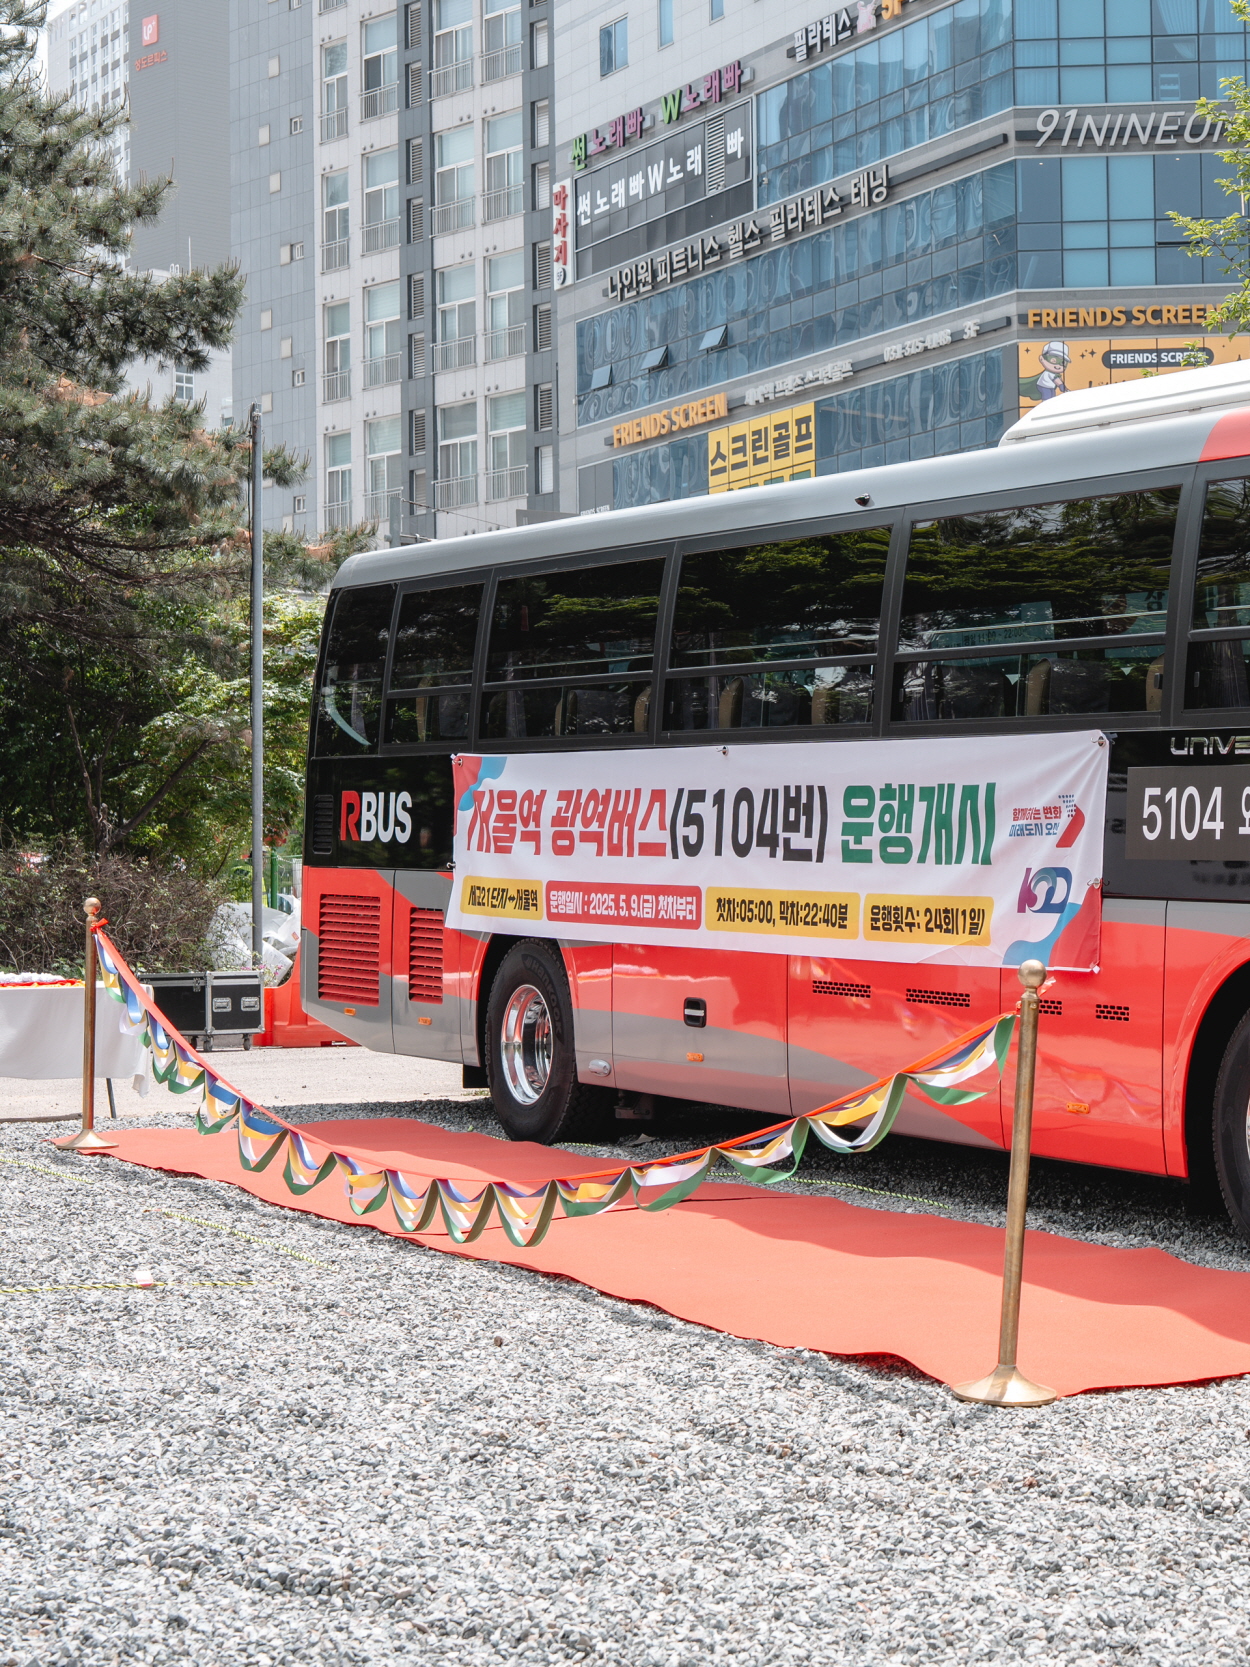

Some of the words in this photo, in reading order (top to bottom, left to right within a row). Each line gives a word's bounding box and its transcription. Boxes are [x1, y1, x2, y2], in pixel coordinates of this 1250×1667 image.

[794, 8, 852, 62] 필라테스
[553, 185, 569, 266] 마사지
[608, 262, 654, 302] 나인원
[656, 235, 722, 285] 피트니스
[727, 218, 761, 259] 헬스
[769, 186, 843, 243] 필라테스
[851, 164, 889, 208] 태닝
[1027, 306, 1127, 328] FRIENDS
[806, 358, 853, 385] 스크린골프
[963, 319, 980, 341] 3F
[1110, 352, 1157, 365] FRIENDS
[612, 410, 671, 449] FRIENDS
[671, 392, 728, 436] SCREEN
[710, 414, 813, 477] 스크린골프
[466, 789, 547, 855] 서울역
[551, 785, 828, 864] 광역버스(5104번)
[841, 782, 997, 866] 운행개시
[1009, 823, 1043, 837] 미래도시
[1045, 822, 1060, 836] 오산
[1012, 807, 1041, 821] 함께하는
[1042, 805, 1062, 819] 변화
[1142, 786, 1224, 841] 5104
[550, 890, 582, 915] 운행일시
[658, 895, 696, 921] 첫차부터
[779, 900, 848, 930] 막차:22:40분
[870, 904, 920, 933] 운행횟수:
[924, 907, 986, 936] 24회(1일)
